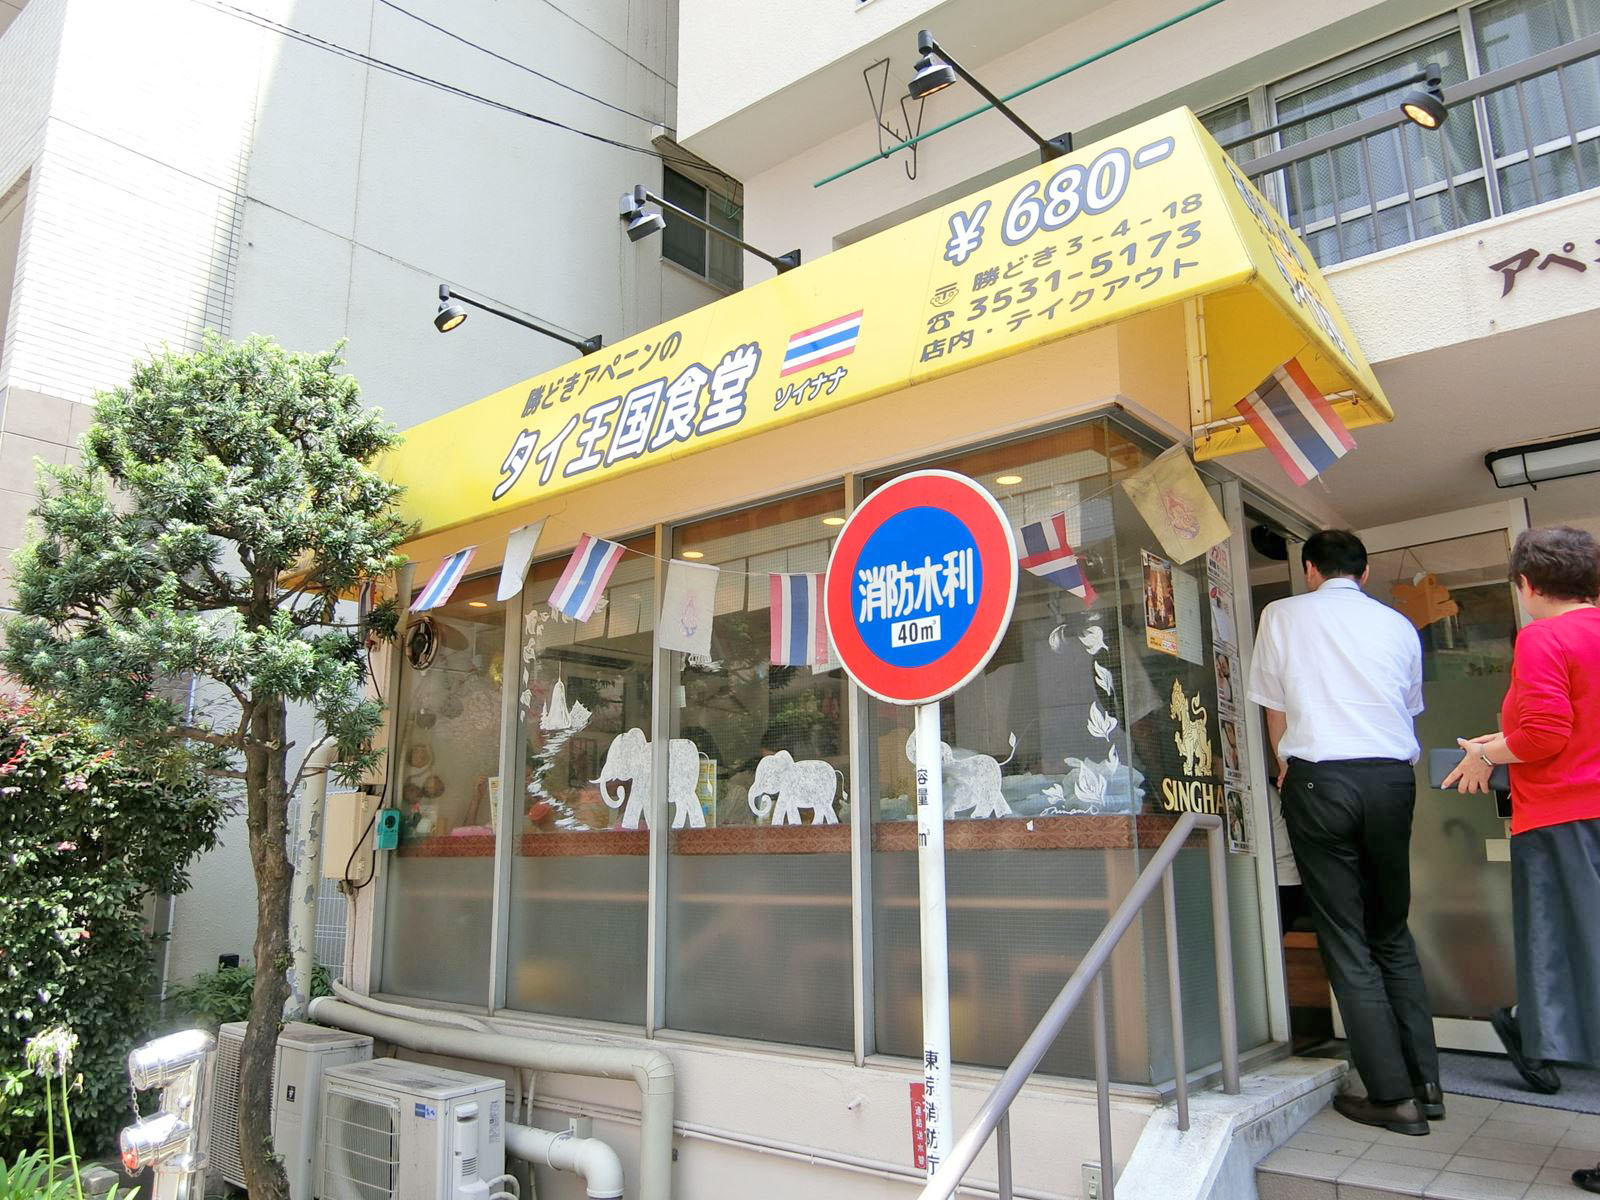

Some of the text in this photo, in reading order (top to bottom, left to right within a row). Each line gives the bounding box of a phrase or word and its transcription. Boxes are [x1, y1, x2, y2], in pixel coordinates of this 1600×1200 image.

[1488, 239, 1600, 298] アペ
[521, 331, 682, 417] 勝どきアペニンの
[774, 367, 847, 411] ソイナナ
[492, 341, 762, 500] タイ王国食堂
[858, 547, 974, 624] 消防水利
[1162, 777, 1226, 814] SINGHA
